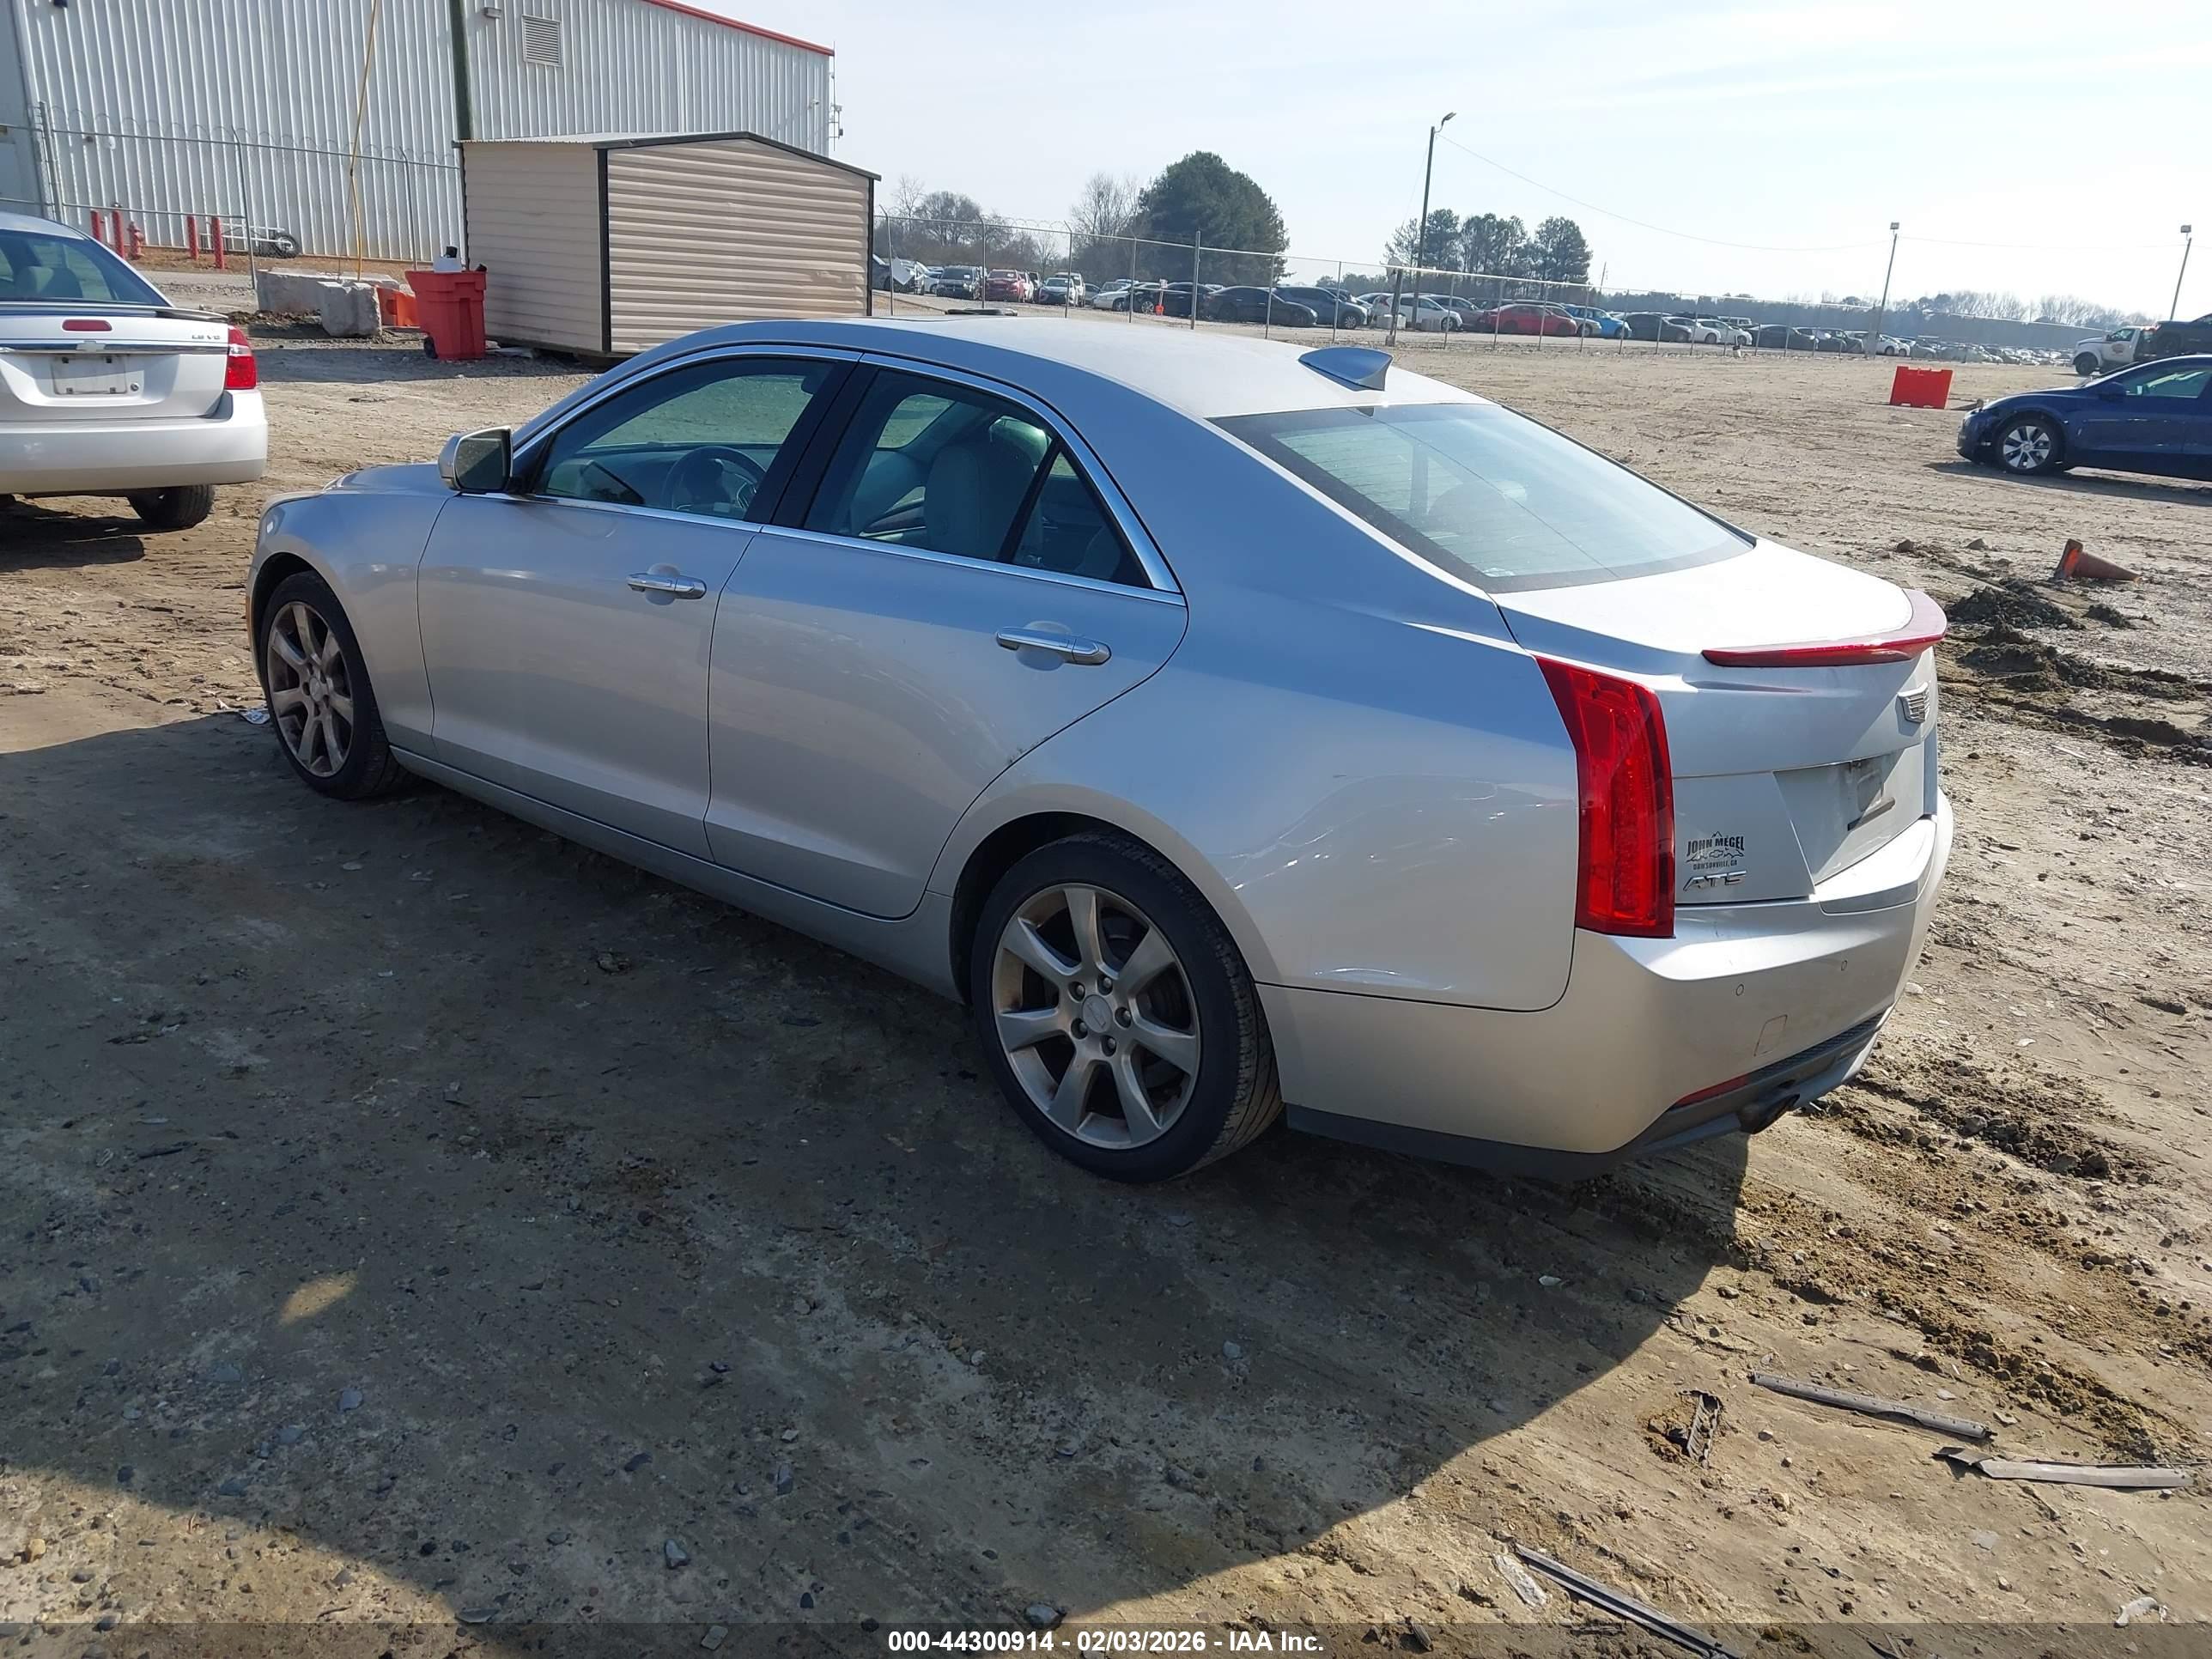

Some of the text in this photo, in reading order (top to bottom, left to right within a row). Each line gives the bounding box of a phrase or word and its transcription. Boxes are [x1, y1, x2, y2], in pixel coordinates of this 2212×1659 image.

[1686, 836, 1745, 857] JOHN MEGEL
[1683, 870, 1747, 891] ATS
